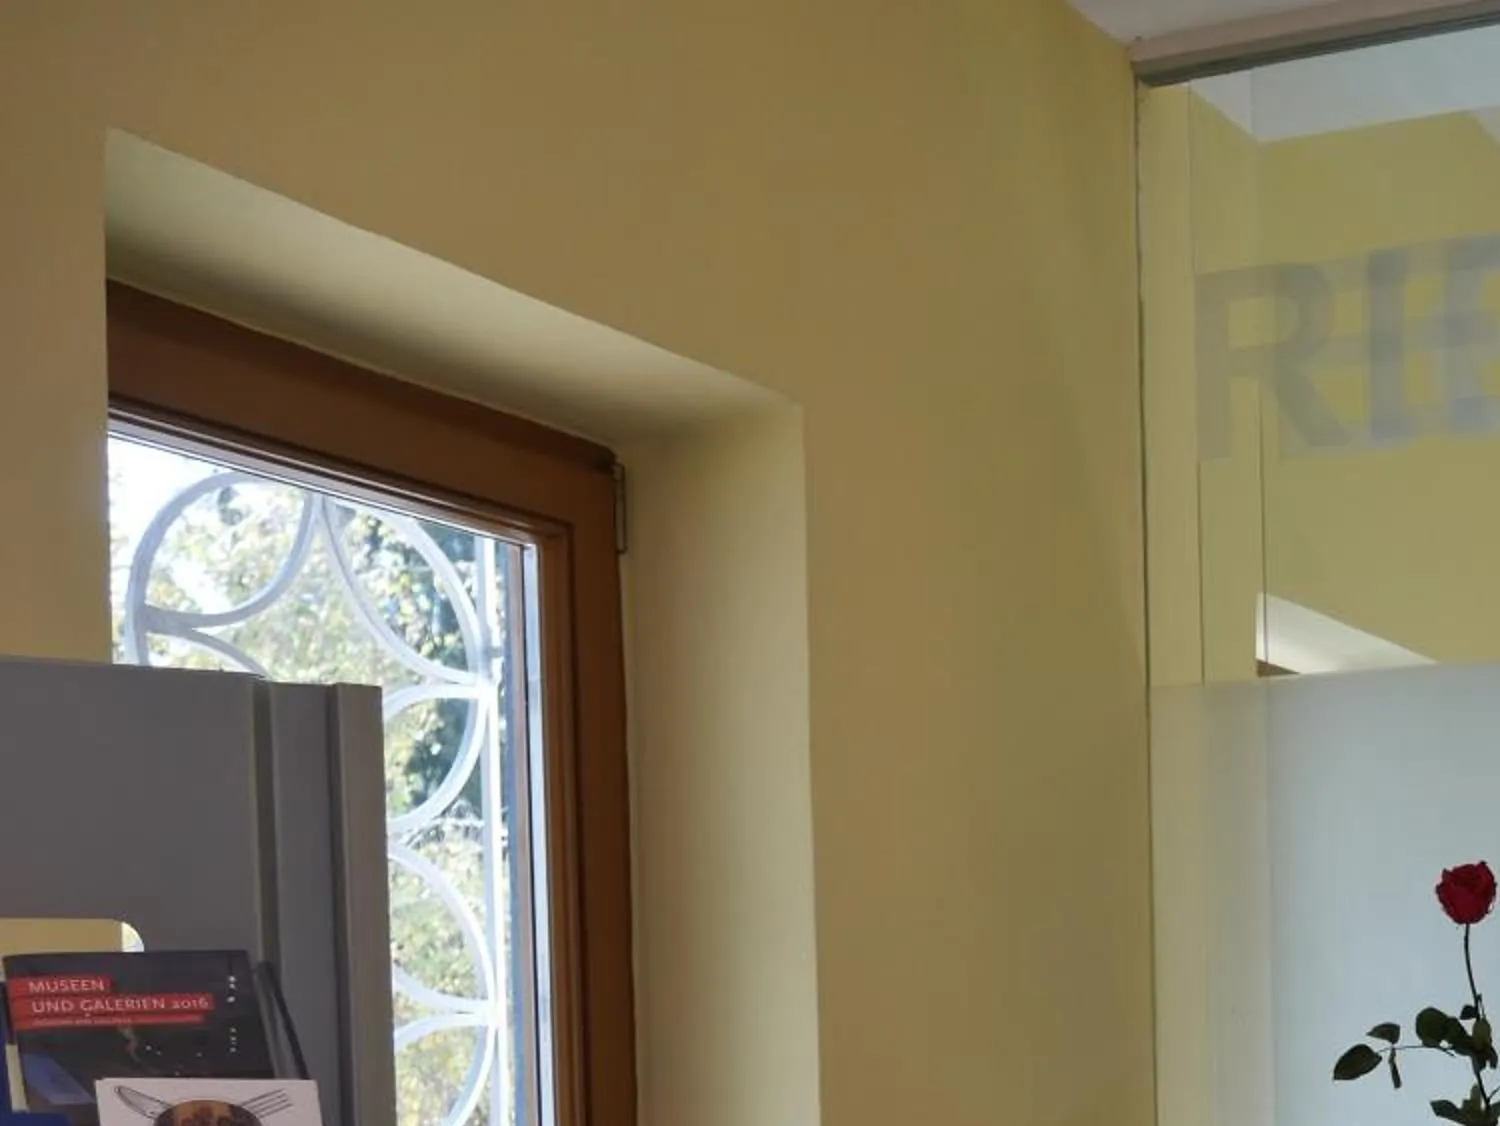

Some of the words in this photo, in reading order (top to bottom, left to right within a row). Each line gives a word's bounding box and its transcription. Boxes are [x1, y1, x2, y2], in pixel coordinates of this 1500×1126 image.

[28, 979, 106, 995] MUSEEN
[31, 999, 75, 1015] UND
[79, 997, 167, 1015] GALERIEN
[171, 997, 210, 1012] 2016
